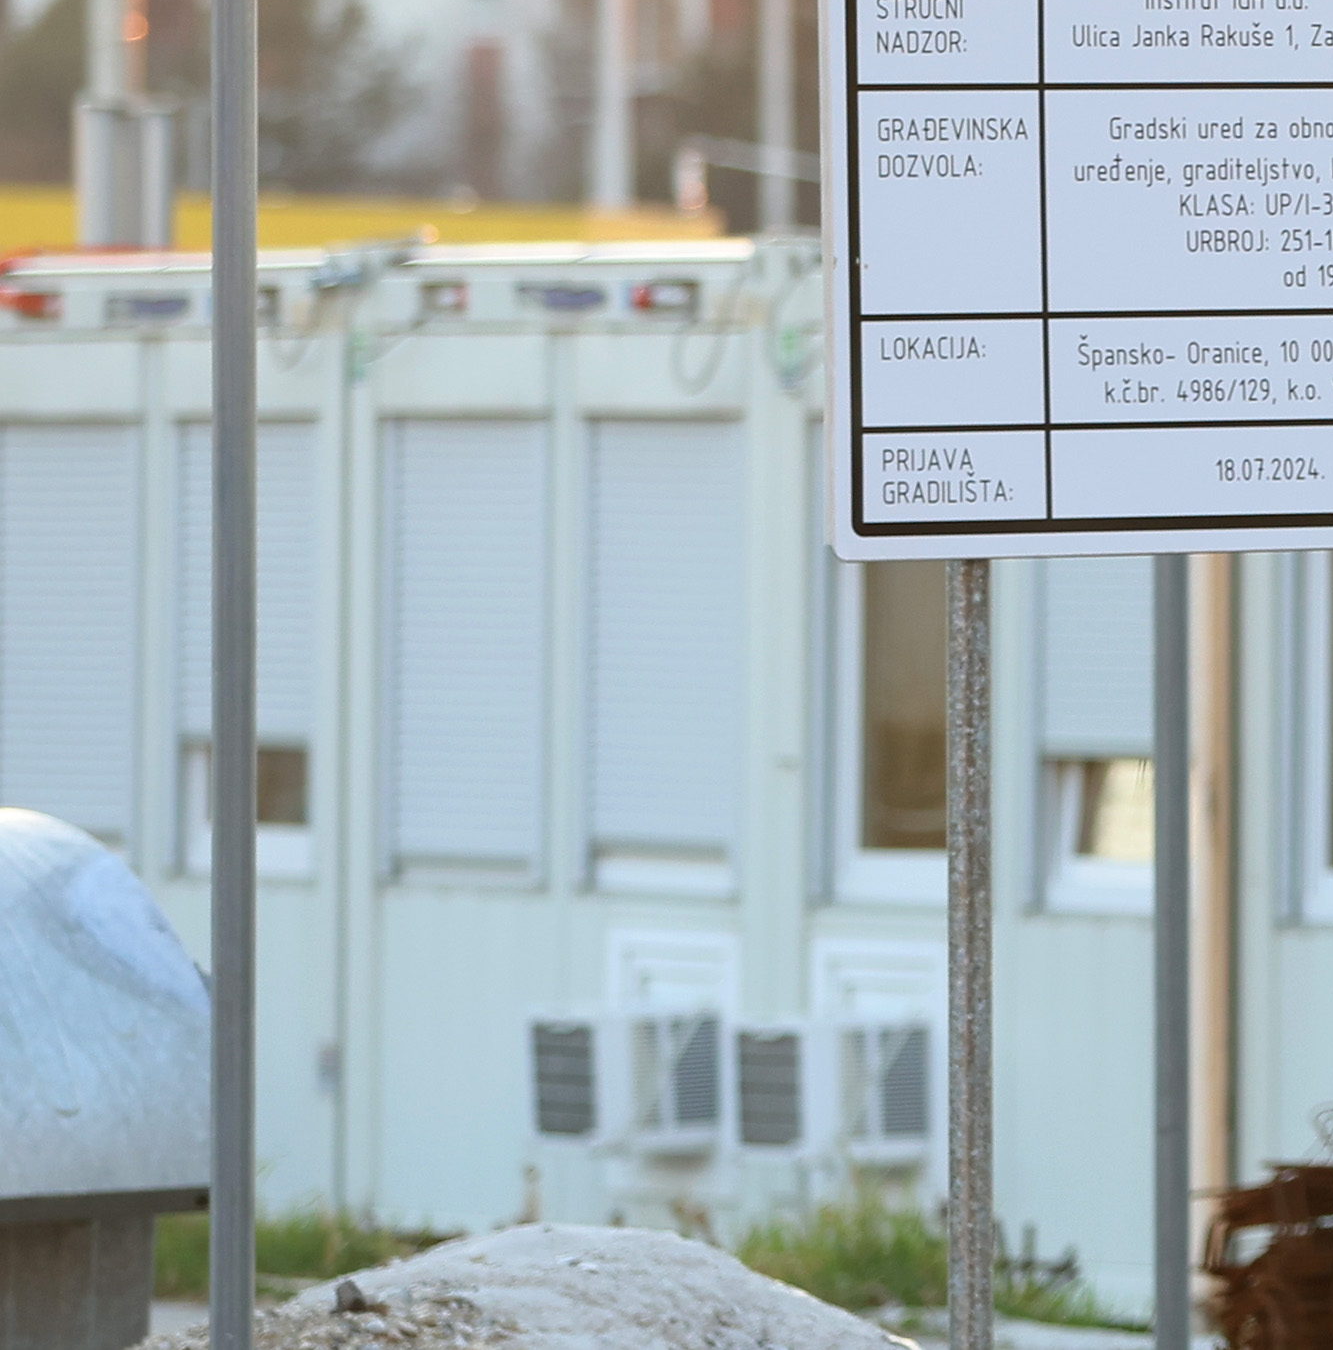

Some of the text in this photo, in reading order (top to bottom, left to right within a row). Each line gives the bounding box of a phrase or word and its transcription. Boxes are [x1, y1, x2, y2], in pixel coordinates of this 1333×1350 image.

[876, 29, 967, 54] NADZOR:
[1072, 24, 1120, 48] Ulica
[1132, 24, 1190, 48] Janka
[1200, 22, 1274, 48] Rakuše
[1285, 24, 1299, 51] 1,
[877, 117, 1029, 142] GRAĐEVINSKA
[1109, 116, 1187, 141] Gradski
[1197, 116, 1244, 140] ured
[1255, 121, 1278, 139] za
[877, 153, 983, 179] DOZVOLA:
[1074, 153, 1172, 188] uređenje,
[1182, 157, 1321, 188] graditeljstvo,
[1179, 193, 1255, 217] KLASA:
[1186, 229, 1270, 253] URBROJ:
[1283, 264, 1307, 288] od
[880, 335, 986, 361] LOKACIJA:
[1077, 334, 1176, 372] Špansko-
[1187, 341, 1269, 367] Oranice,
[1280, 339, 1300, 363] 10
[1104, 378, 1165, 404] k.č.br.
[1176, 377, 1277, 405] 4986/129,
[1287, 378, 1321, 401] k.o.
[882, 447, 975, 474] PRIJAVA
[1215, 457, 1325, 482] 18.07.2024.
[882, 471, 1013, 505] GRADILIŠTA:
